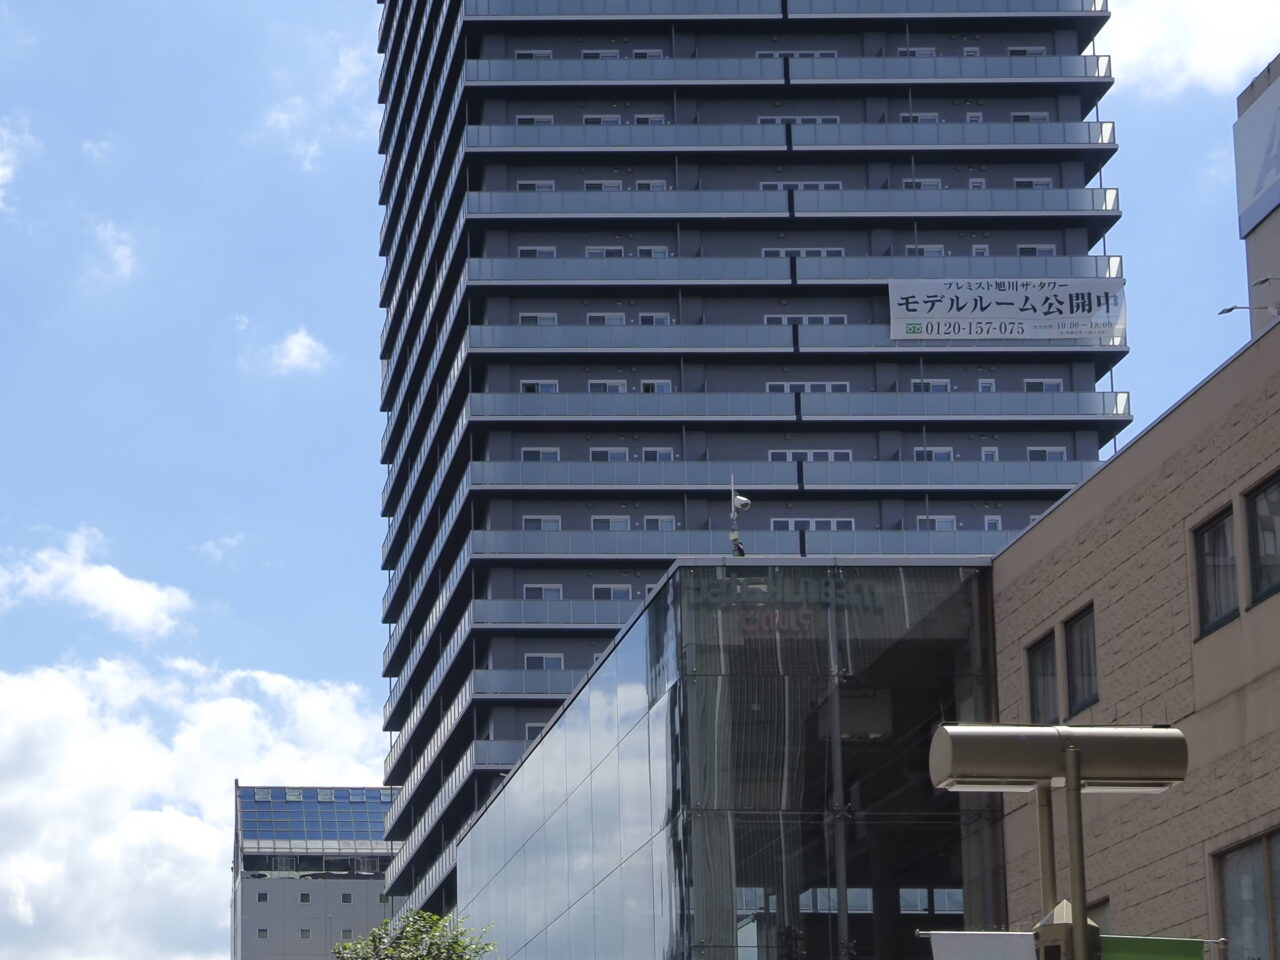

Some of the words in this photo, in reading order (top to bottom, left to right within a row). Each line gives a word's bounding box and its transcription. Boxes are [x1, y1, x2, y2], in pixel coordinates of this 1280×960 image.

[897, 291, 1119, 317] モデルルーム公開中
[925, 321, 1025, 336] 0120-157-075
